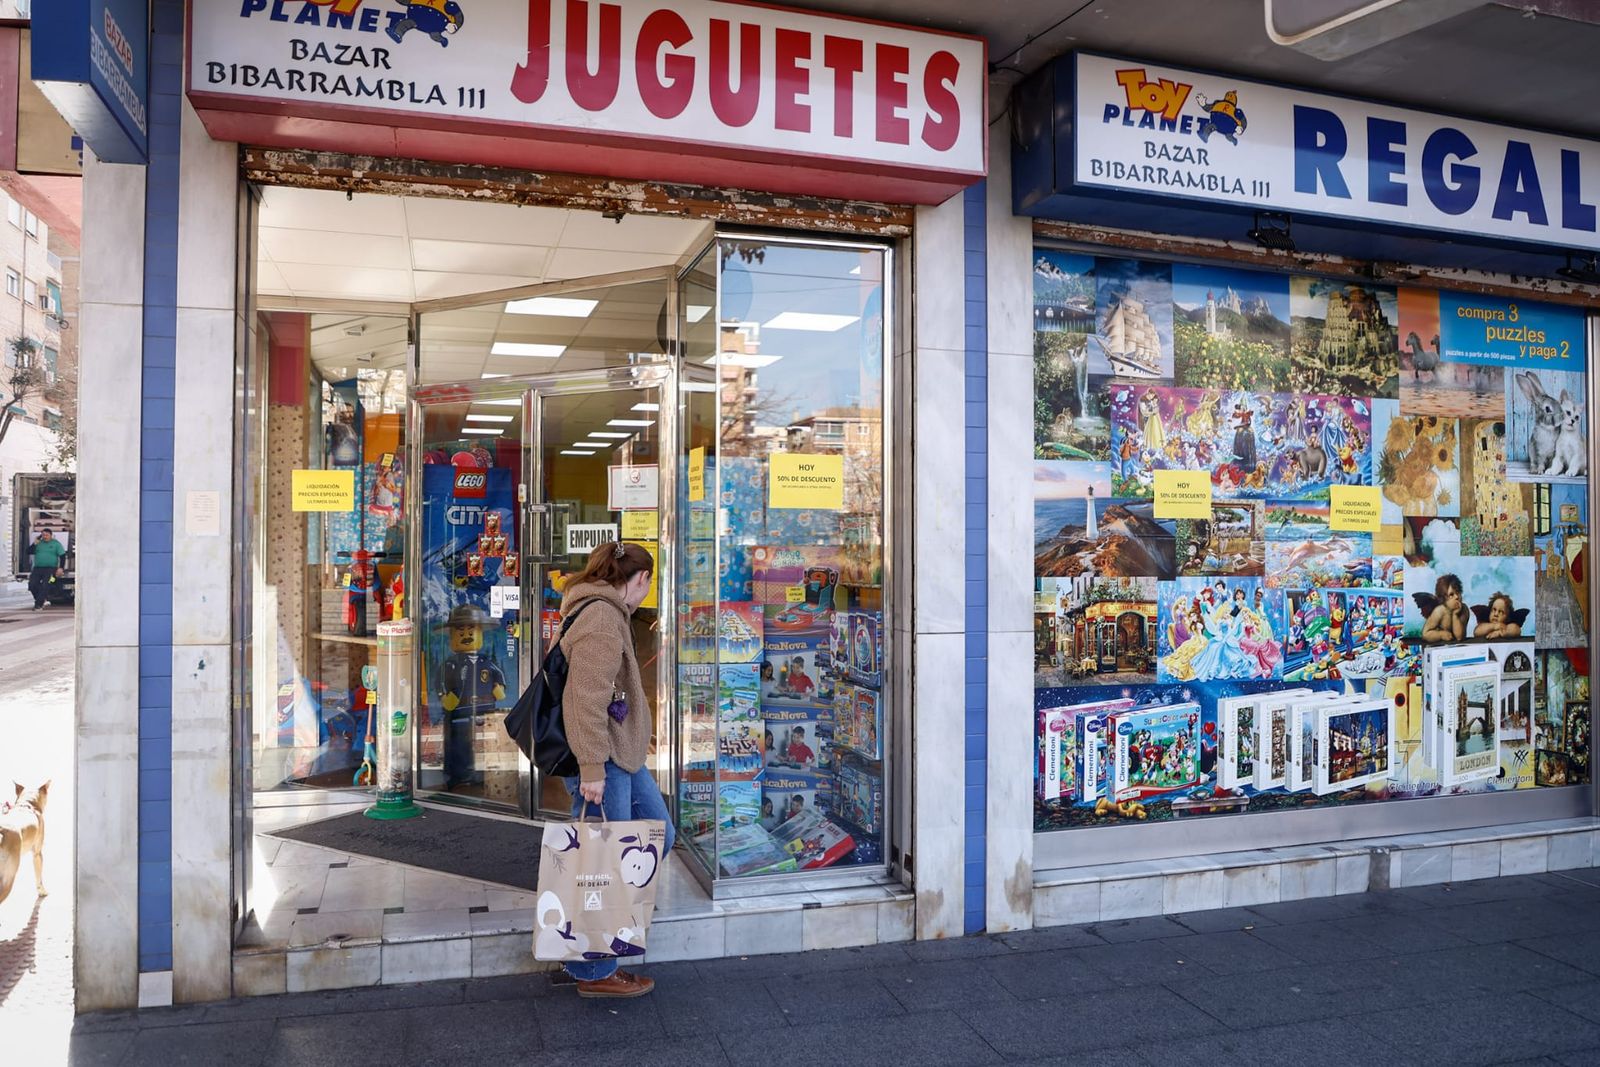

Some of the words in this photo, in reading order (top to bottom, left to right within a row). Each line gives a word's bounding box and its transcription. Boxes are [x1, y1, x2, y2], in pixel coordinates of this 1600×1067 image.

[105, 8, 133, 76] BAZAR
[290, 39, 392, 70] BAZAR
[206, 61, 447, 106] BIBARRAMBLA
[510, 0, 960, 152] JUGUETES
[1144, 141, 1209, 166] BAZAR
[1090, 159, 1245, 195] BIBARRAMBLA
[1293, 104, 1597, 232] REGAL
[1457, 306, 1505, 322] compra
[1508, 303, 1519, 322] 3
[1486, 325, 1545, 343] puzzles
[1519, 345, 1526, 358] y
[1529, 346, 1557, 359] paga
[1560, 340, 1570, 358] 2
[798, 464, 815, 472] HOY
[457, 475, 484, 487] LEGO
[447, 505, 489, 525] CITY
[505, 593, 519, 602] VISA
[687, 666, 711, 675] 1000
[1459, 754, 1492, 770] LONDON
[687, 784, 712, 793] 1000
[1487, 775, 1533, 786] Clementoni
